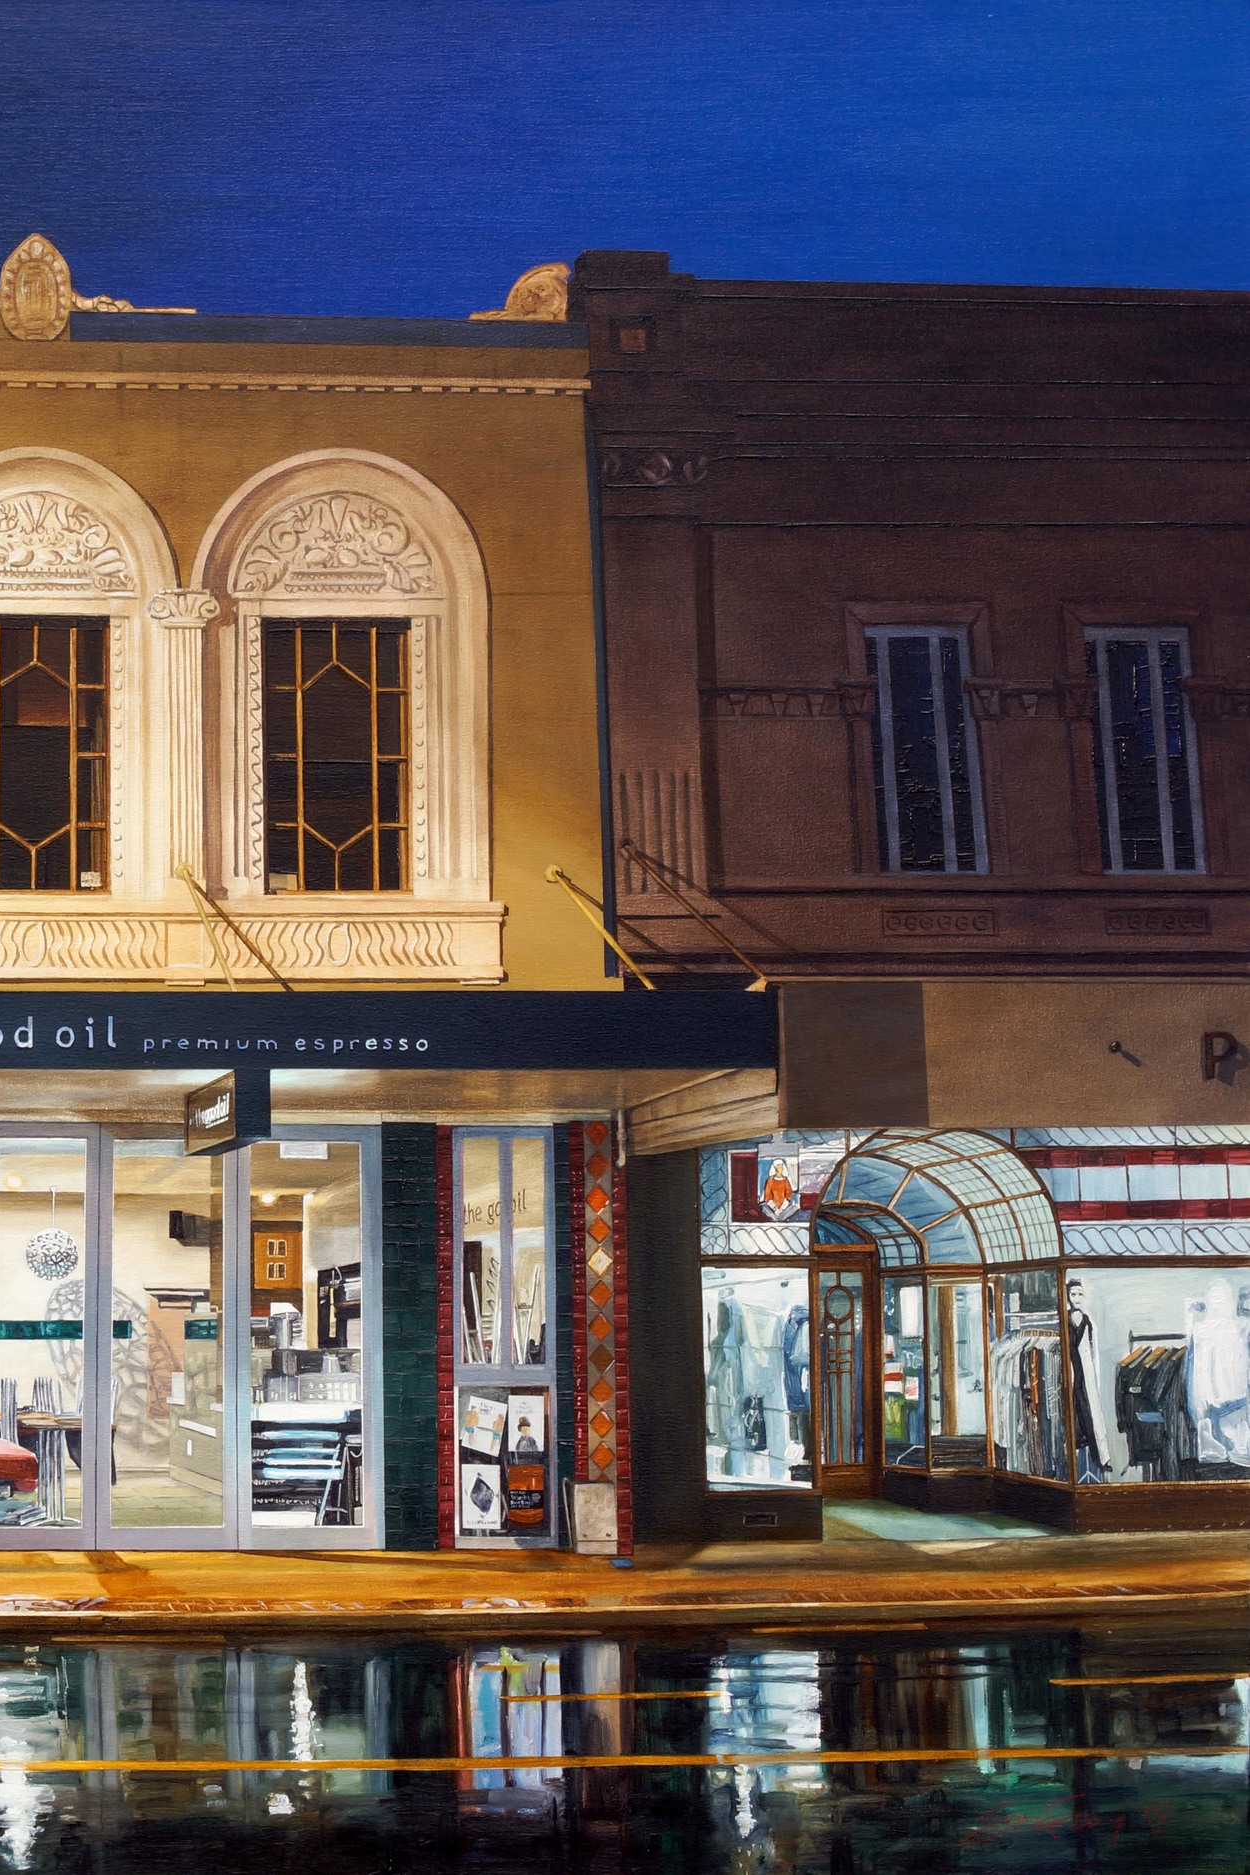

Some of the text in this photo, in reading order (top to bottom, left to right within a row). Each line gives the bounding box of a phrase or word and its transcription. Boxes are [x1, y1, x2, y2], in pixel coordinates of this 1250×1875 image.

[55, 1015, 117, 1049] oil
[143, 1037, 278, 1053] premium
[295, 1038, 429, 1053] espresso
[463, 1202, 482, 1225] the
